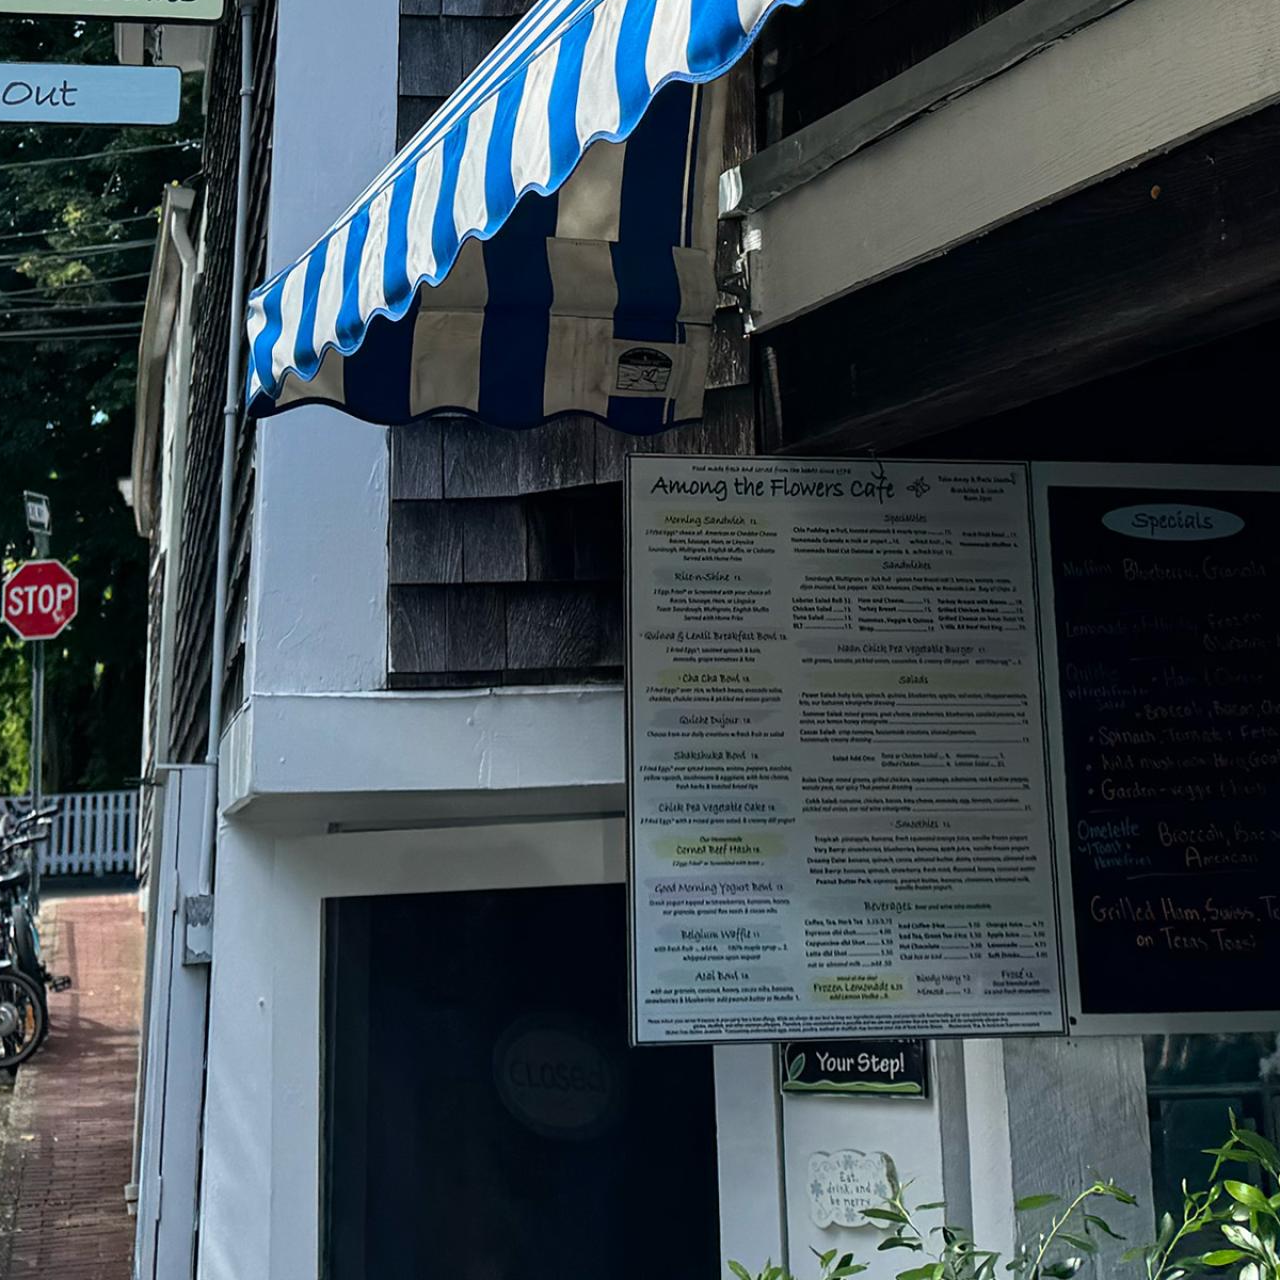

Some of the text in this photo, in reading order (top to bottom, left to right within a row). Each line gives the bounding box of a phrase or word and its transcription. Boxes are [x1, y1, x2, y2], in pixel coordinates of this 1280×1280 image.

[650, 476, 728, 502] Among
[733, 475, 765, 497] the
[770, 476, 845, 498] Flowers
[1131, 510, 1214, 535] Specials
[7, 583, 74, 617] STOP
[1089, 894, 1155, 923] Grilled
[815, 1051, 905, 1080] Your Step!
